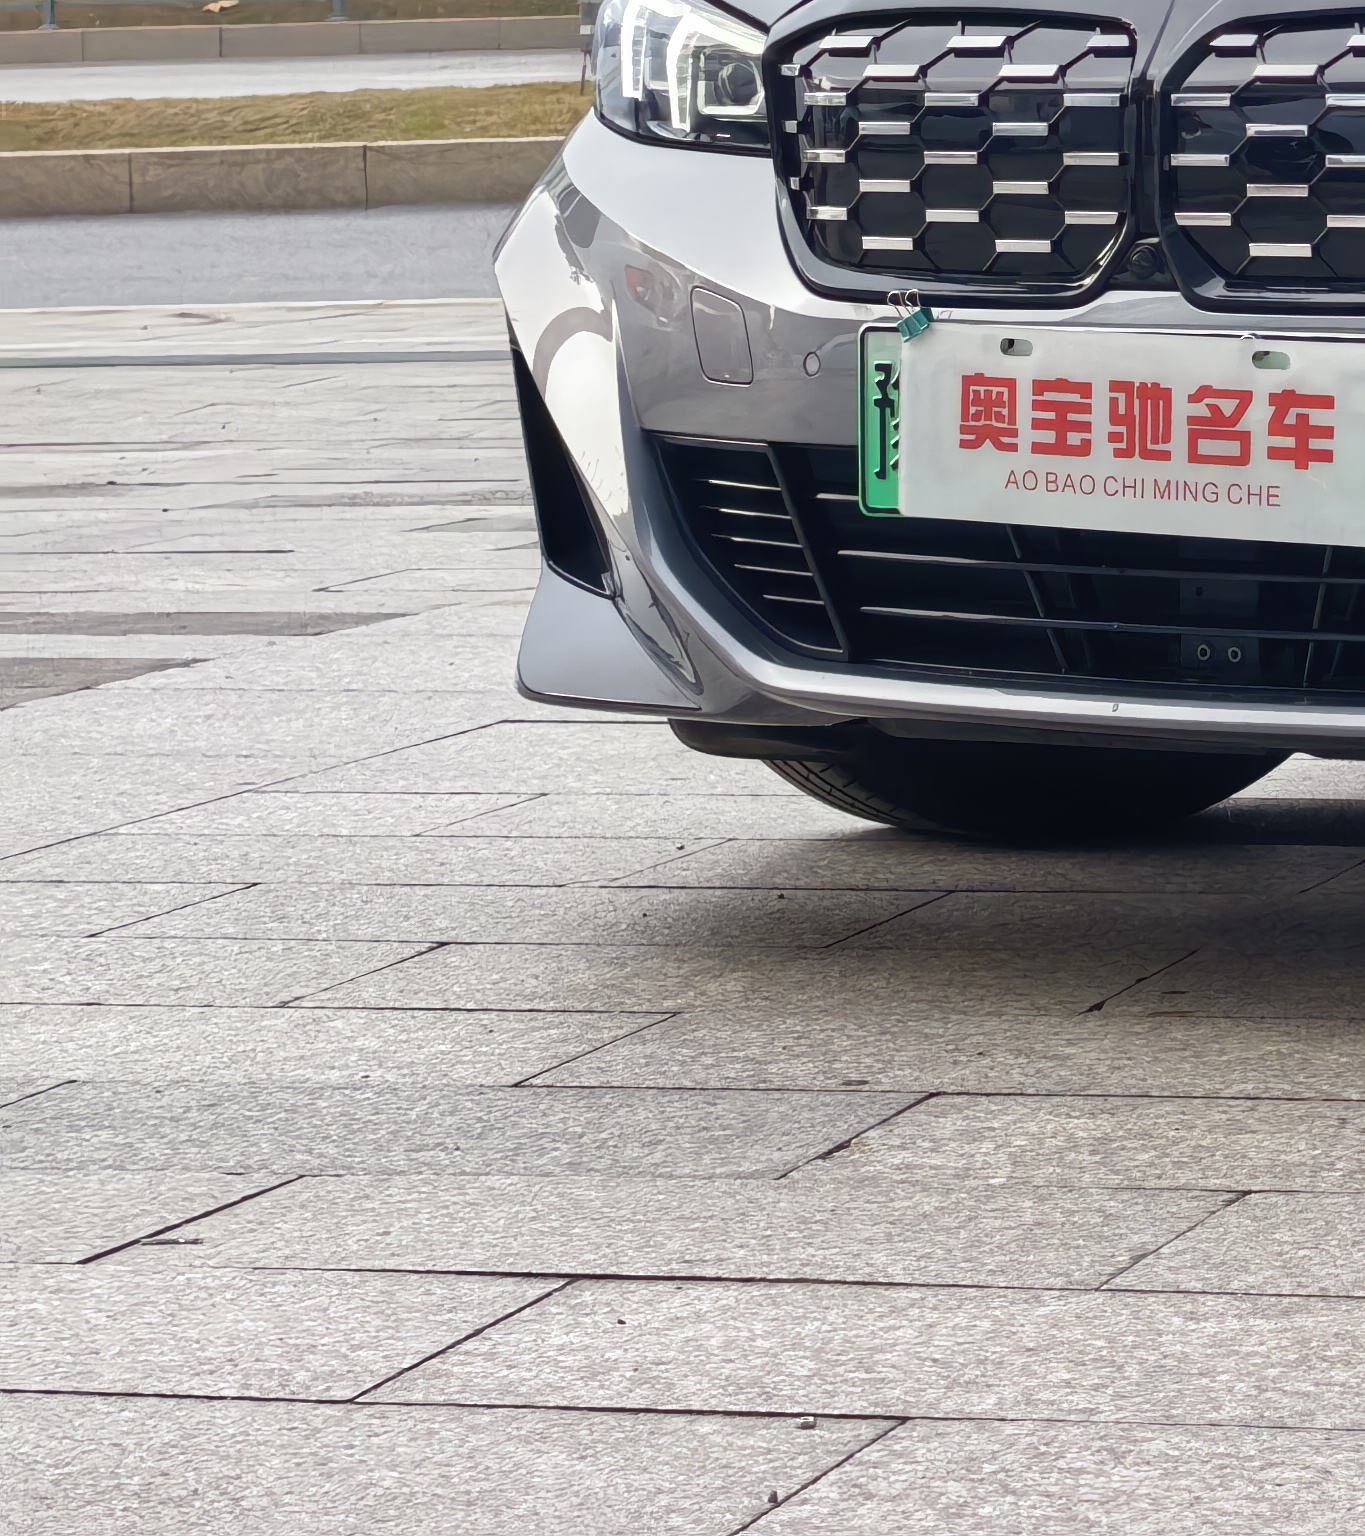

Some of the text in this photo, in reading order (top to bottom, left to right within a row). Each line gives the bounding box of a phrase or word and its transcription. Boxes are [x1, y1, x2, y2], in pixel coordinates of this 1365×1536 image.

[958, 372, 1336, 472] 奥宝驰名车
[1004, 469, 1282, 507] AO BAO CHI MING CHE
